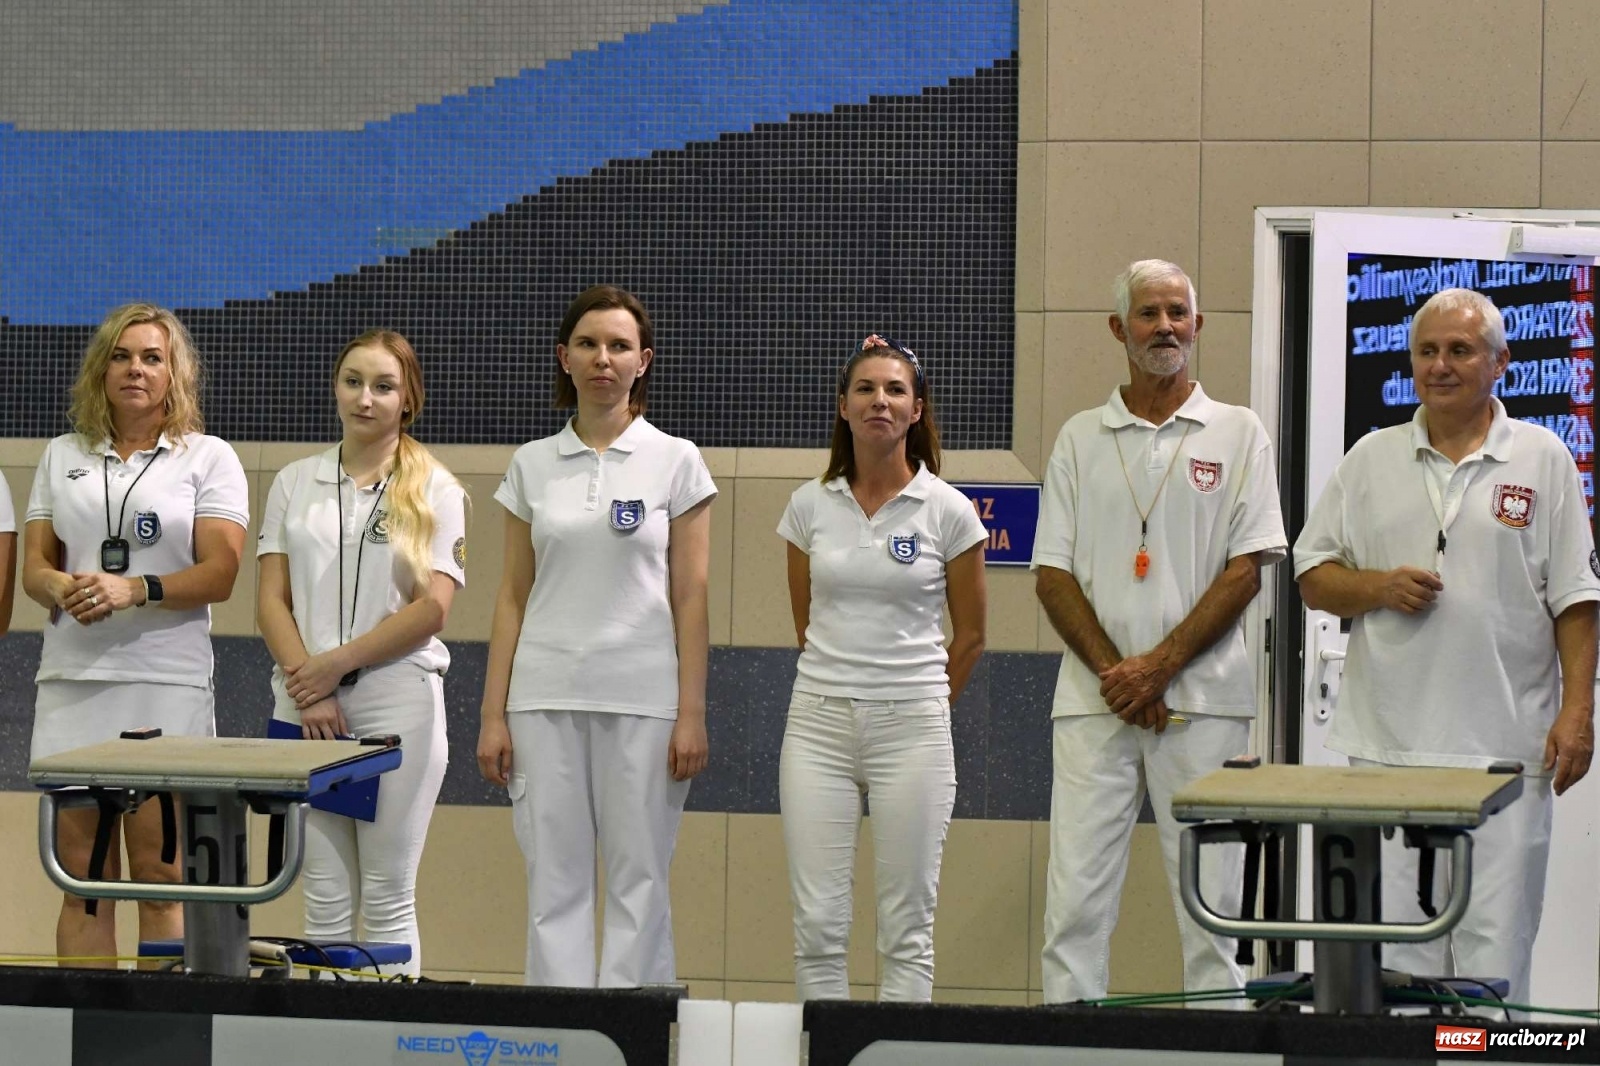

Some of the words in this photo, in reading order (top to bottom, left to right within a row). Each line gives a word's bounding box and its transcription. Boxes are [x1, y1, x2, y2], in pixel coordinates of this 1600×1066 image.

[619, 510, 636, 525] S
[140, 520, 154, 537] S
[897, 542, 913, 557] S
[187, 805, 220, 886] 5
[1321, 833, 1357, 923] 6
[397, 1035, 455, 1053] NEED
[500, 1041, 558, 1058] SWIM
